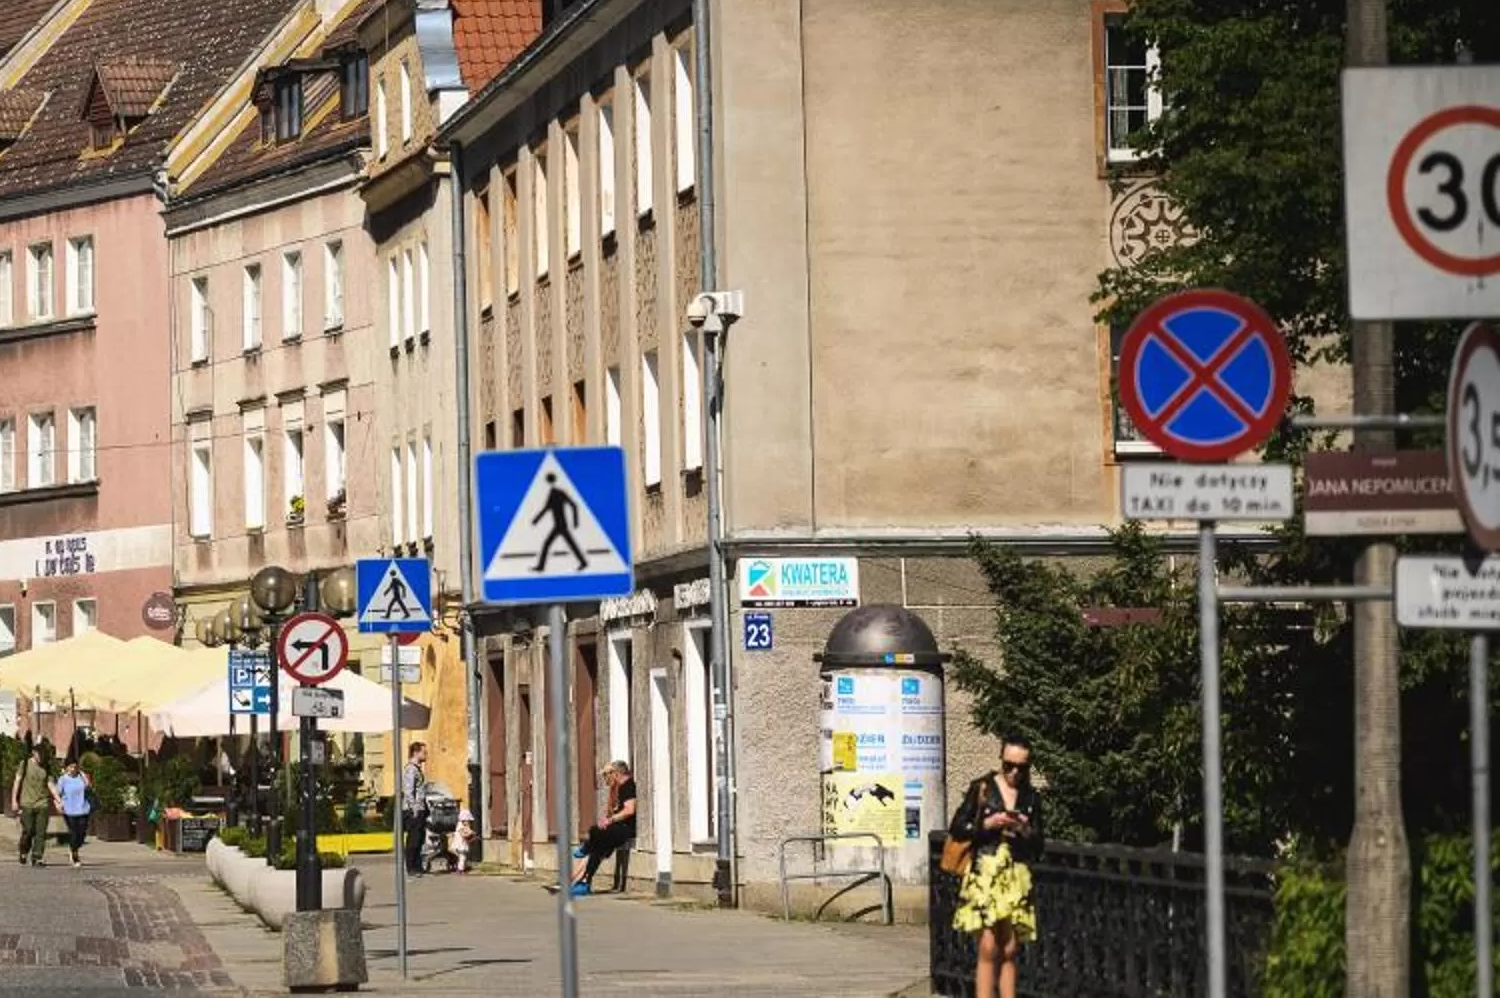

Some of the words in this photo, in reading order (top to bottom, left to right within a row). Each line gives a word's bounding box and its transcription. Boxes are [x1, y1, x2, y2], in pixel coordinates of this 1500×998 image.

[1309, 478, 1350, 497] JANA
[1131, 496, 1174, 512] TAXI
[781, 563, 850, 585] KWATERA
[747, 623, 770, 647] 23
